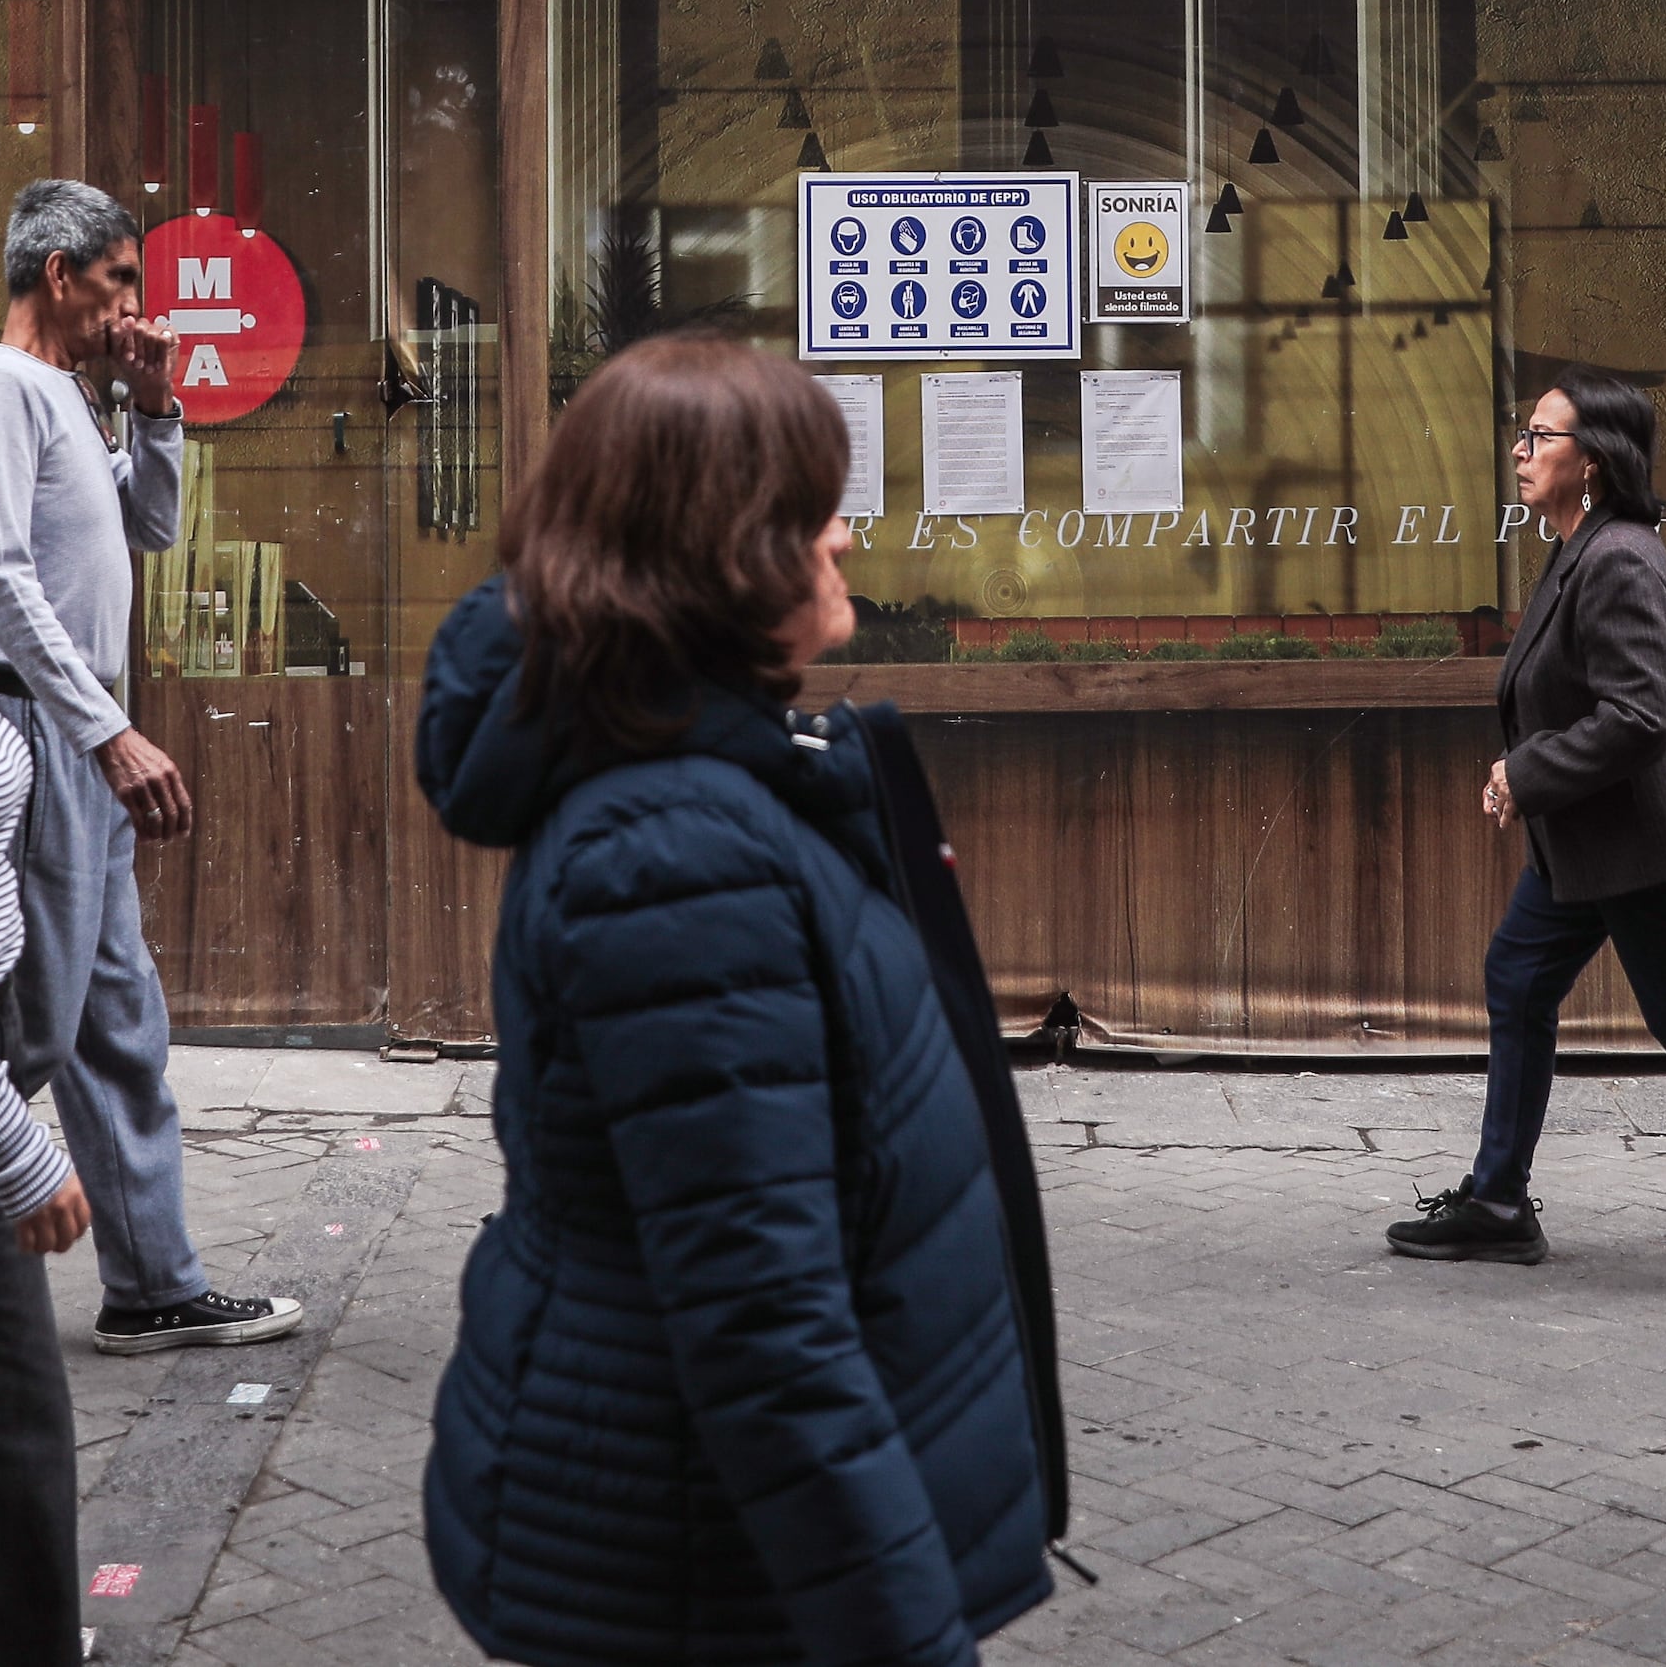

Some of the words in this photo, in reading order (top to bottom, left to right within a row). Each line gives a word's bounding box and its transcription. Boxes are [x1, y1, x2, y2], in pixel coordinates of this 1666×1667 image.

[852, 193, 878, 204] USO
[882, 192, 966, 204] OBLIGATORIO
[970, 192, 987, 203] DE
[990, 191, 1025, 205] (EPP)
[1101, 192, 1178, 213] SONRÍA
[178, 257, 232, 300] M
[1104, 302, 1138, 312] siendo
[1139, 301, 1179, 312] filmado
[1114, 291, 1145, 301] Usted
[1146, 291, 1168, 301] está
[182, 344, 229, 386] A
[906, 511, 982, 550] ES
[1018, 506, 1358, 549] COMPARTIR
[1391, 505, 1462, 545] EL
